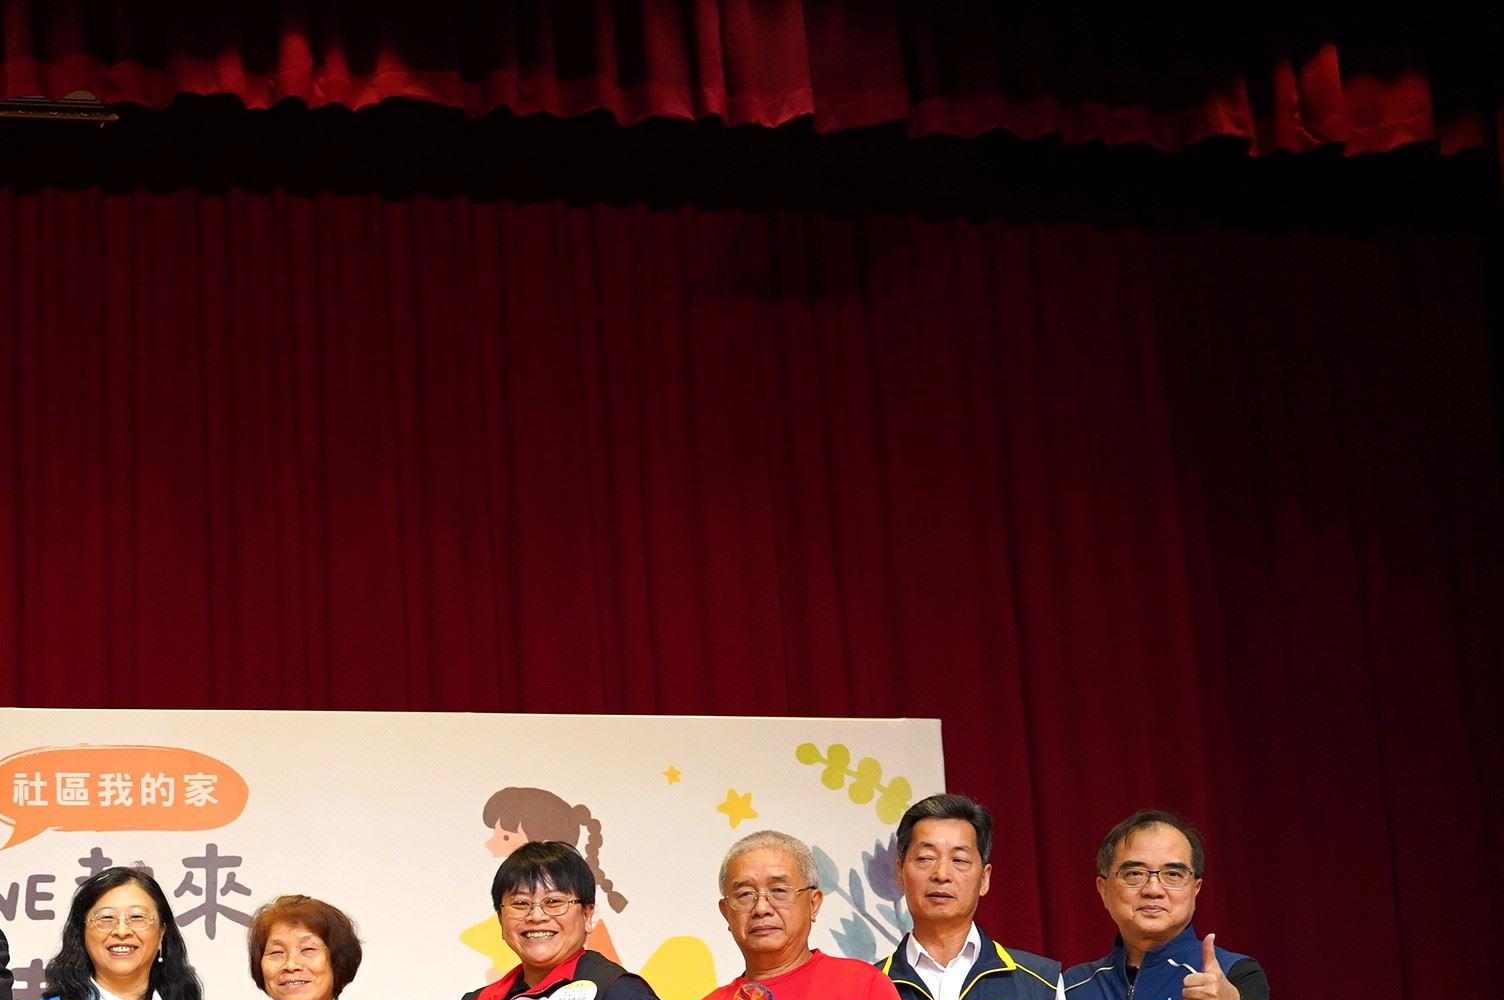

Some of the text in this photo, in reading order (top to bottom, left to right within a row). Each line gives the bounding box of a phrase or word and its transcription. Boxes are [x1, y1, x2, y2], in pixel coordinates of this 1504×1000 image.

[12, 771, 219, 807] 社區我的家
